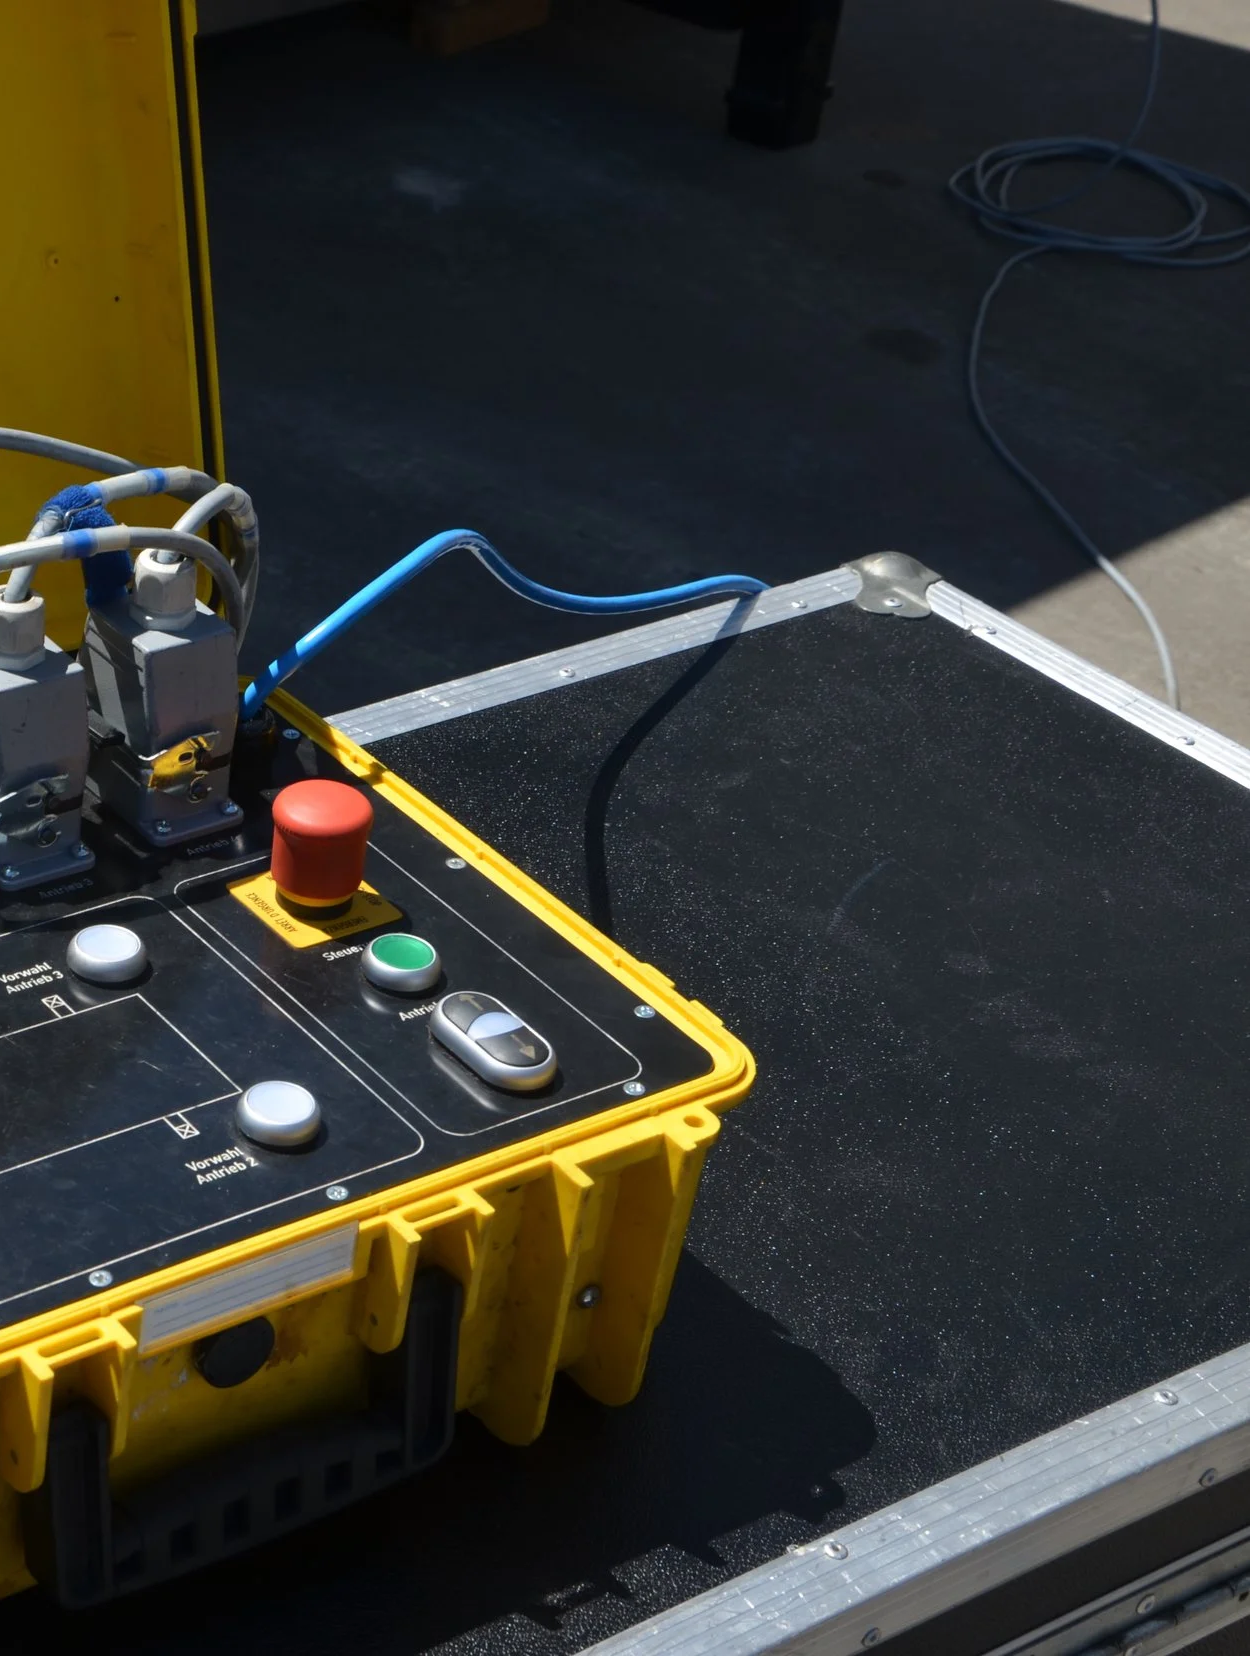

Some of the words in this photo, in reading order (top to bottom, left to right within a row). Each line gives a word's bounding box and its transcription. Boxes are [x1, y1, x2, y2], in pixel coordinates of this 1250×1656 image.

[5, 973, 54, 995] Antrieb
[53, 970, 64, 980] 3
[185, 1146, 245, 1173] Vorwahl
[195, 1161, 247, 1186] Antrieb
[246, 1156, 259, 1168] 2
